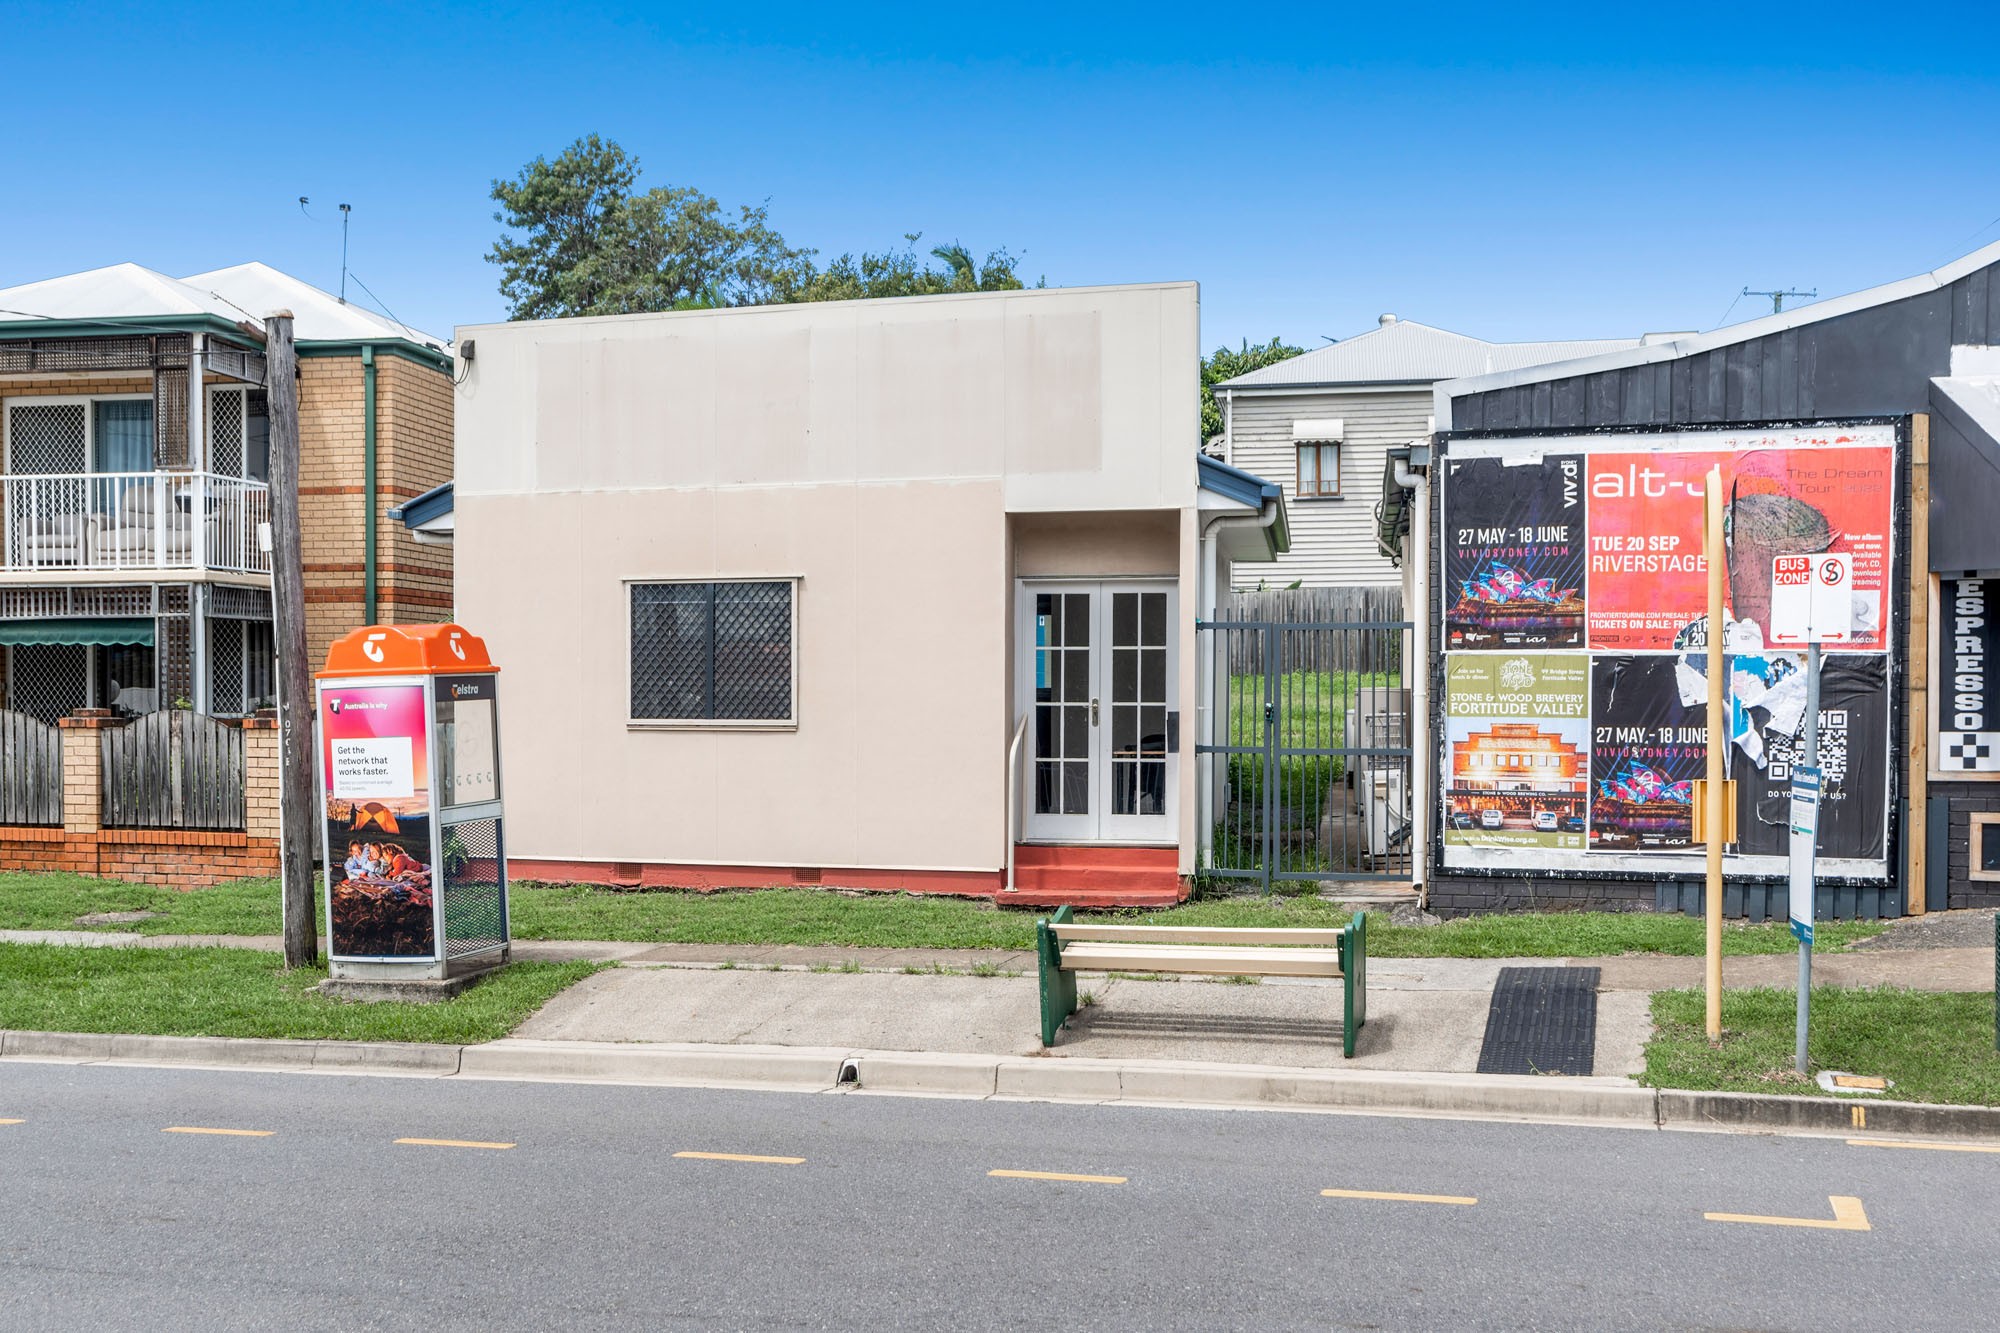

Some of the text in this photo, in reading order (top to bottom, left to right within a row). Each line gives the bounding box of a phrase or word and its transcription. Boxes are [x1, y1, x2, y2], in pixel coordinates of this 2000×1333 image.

[1786, 468, 1883, 479] The Dream
[1797, 483, 1835, 494] Tour
[1458, 529, 1475, 545] 27
[1477, 528, 1507, 545] MAY
[1518, 527, 1533, 543] 18
[1535, 526, 1569, 542] JUNE
[1592, 536, 1680, 551] TUE 20 SEP
[1458, 546, 1569, 559] VIVIDSYDNEY.COM
[1592, 554, 1707, 572] RIVERSTAGE
[1779, 558, 1806, 570] BUS
[1775, 572, 1809, 585] ZONE
[1590, 620, 1628, 629] TICKETS
[1629, 620, 1644, 629] ON
[1645, 620, 1672, 629] SALE:
[1954, 579, 1985, 730] ESPRESSO
[451, 684, 479, 698] Telstra
[1450, 693, 1584, 703] STONE & WOOD BREWERY
[1450, 702, 1584, 716] FORTITUDE VALLEY
[1596, 727, 1613, 743] 27
[1615, 727, 1646, 743] MAY
[1657, 727, 1673, 743] 18
[1675, 727, 1708, 743] JUNE
[338, 746, 366, 755] Get the
[339, 768, 389, 776] works faster.
[1767, 790, 1780, 798] DO
